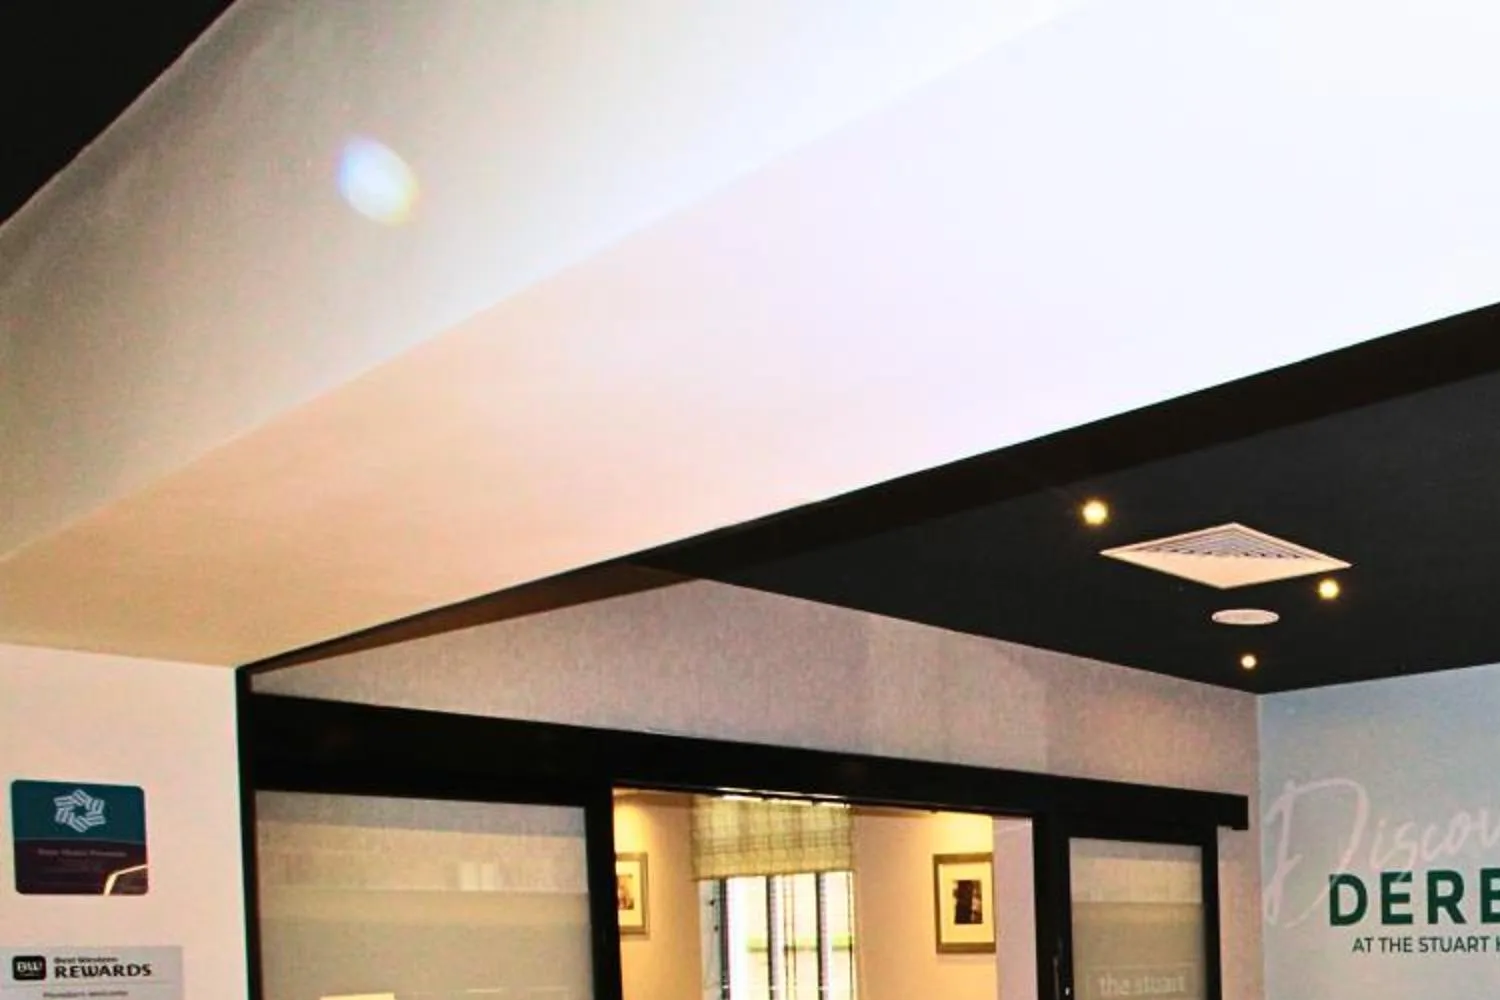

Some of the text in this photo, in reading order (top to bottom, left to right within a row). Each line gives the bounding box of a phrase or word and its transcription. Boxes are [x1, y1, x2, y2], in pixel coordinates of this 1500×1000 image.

[1352, 937, 1374, 953] AT
[1379, 937, 1413, 953] THE
[1419, 936, 1491, 953] STUART
[54, 963, 153, 980] REWARDS
